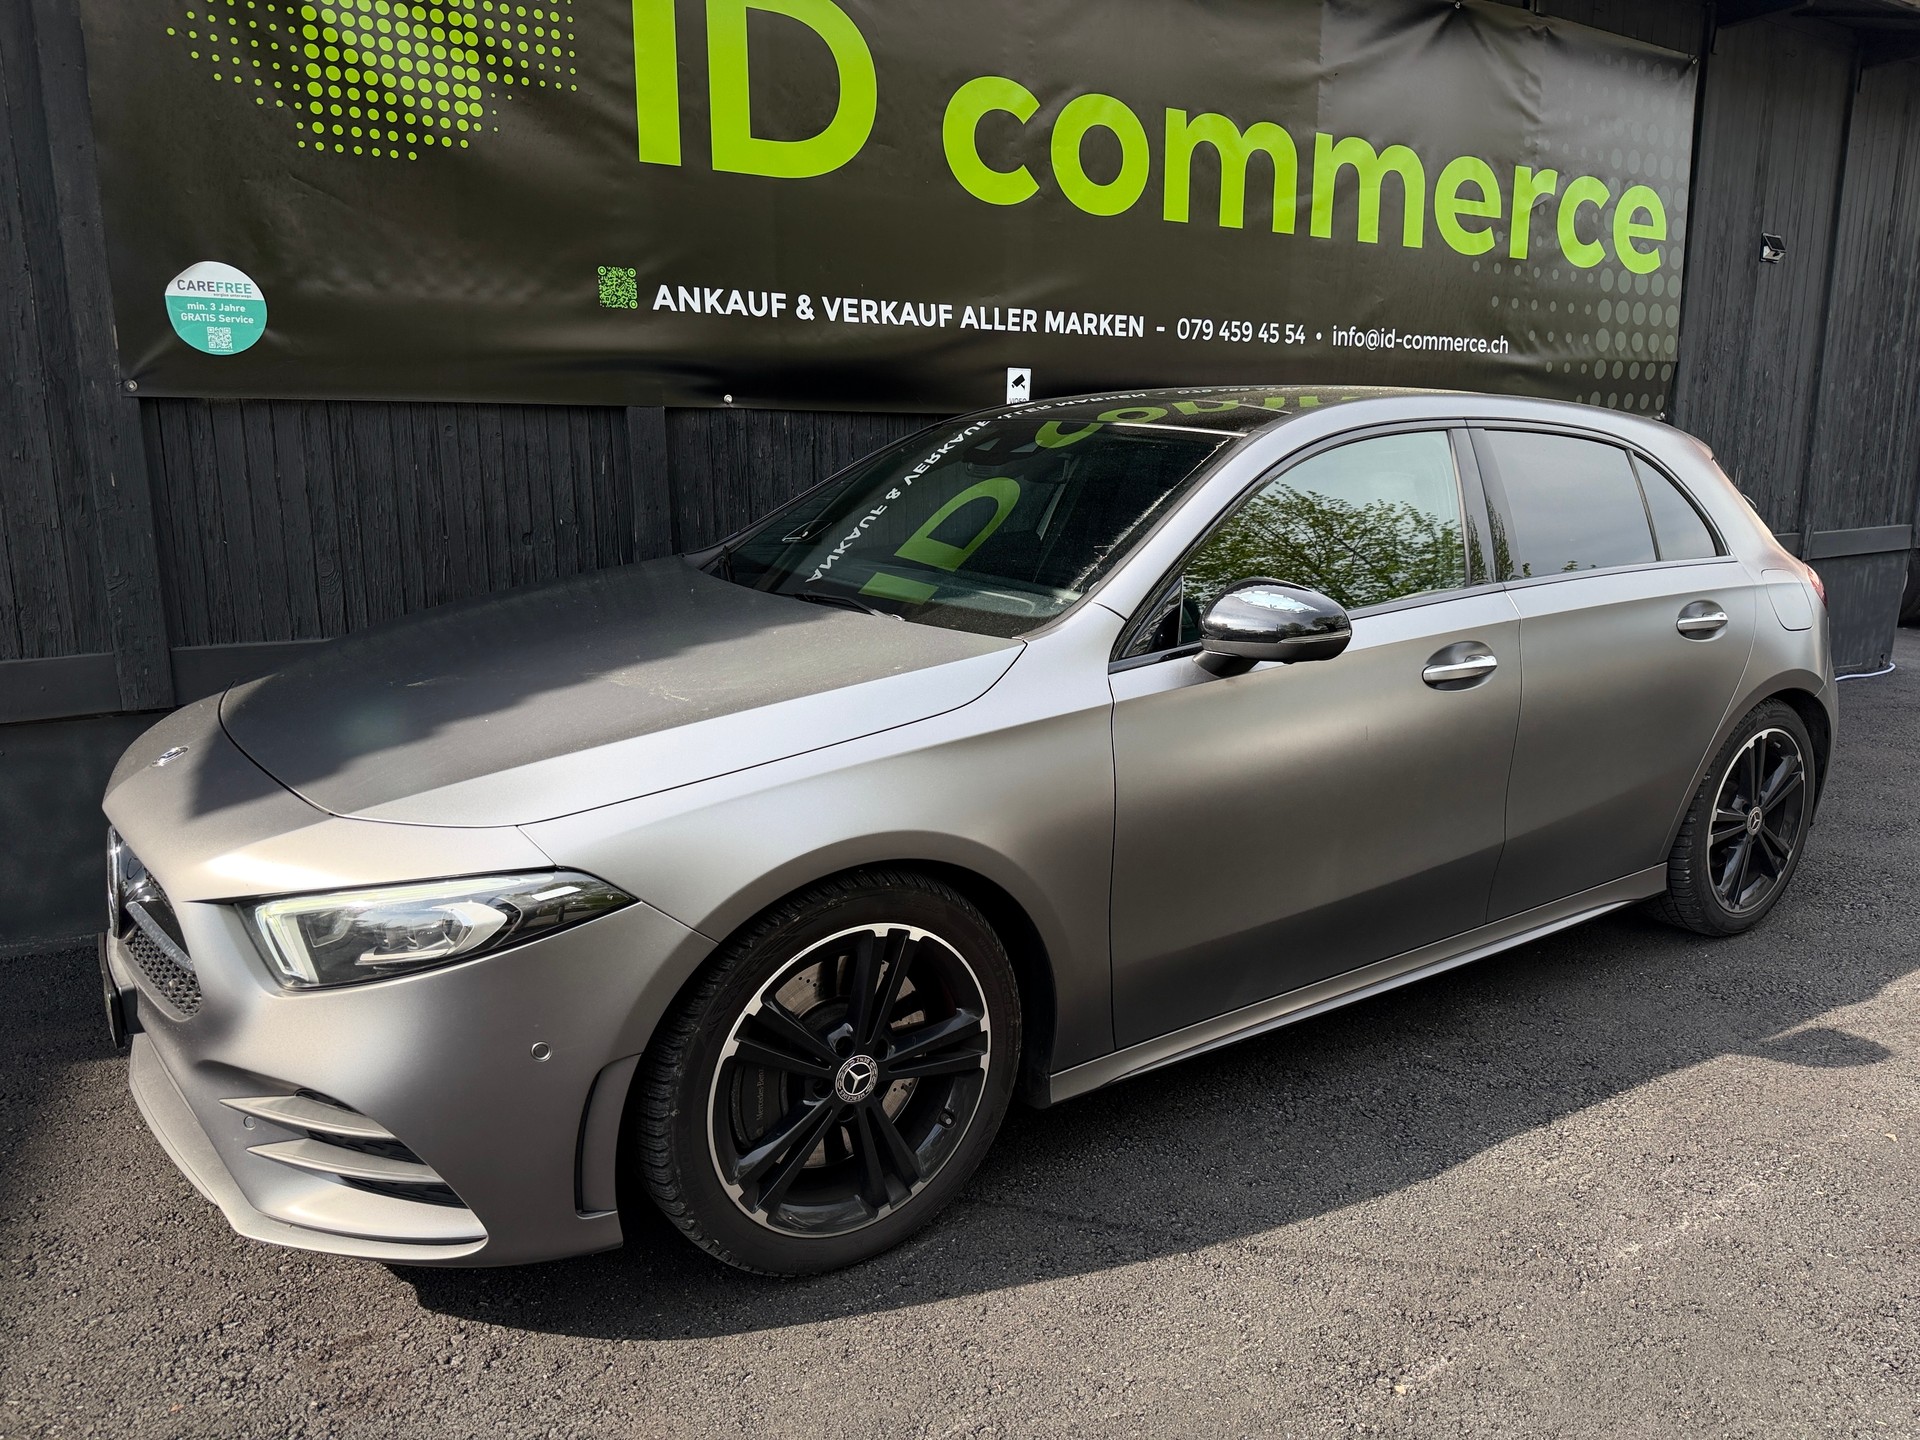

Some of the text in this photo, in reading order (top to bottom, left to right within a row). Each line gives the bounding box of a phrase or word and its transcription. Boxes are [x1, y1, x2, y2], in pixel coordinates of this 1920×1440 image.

[632, 0, 1667, 274] ID commerce
[177, 280, 252, 294] CAREFREE
[187, 302, 246, 312] min. 3 Jahre
[181, 313, 254, 323] GRATIS Service
[653, 285, 786, 318] ANKAUF
[796, 295, 815, 321] &
[822, 297, 953, 328] VERKAUF
[960, 306, 1037, 333] ALLER
[1045, 311, 1144, 338] MARKEN
[1176, 318, 1213, 341] 079
[1218, 320, 1252, 342] 459
[1258, 323, 1280, 344] 45
[1285, 324, 1306, 345] 54
[1332, 325, 1508, 354] info@id-commerce.ch
[839, 1089, 866, 1101] MERCEDES
